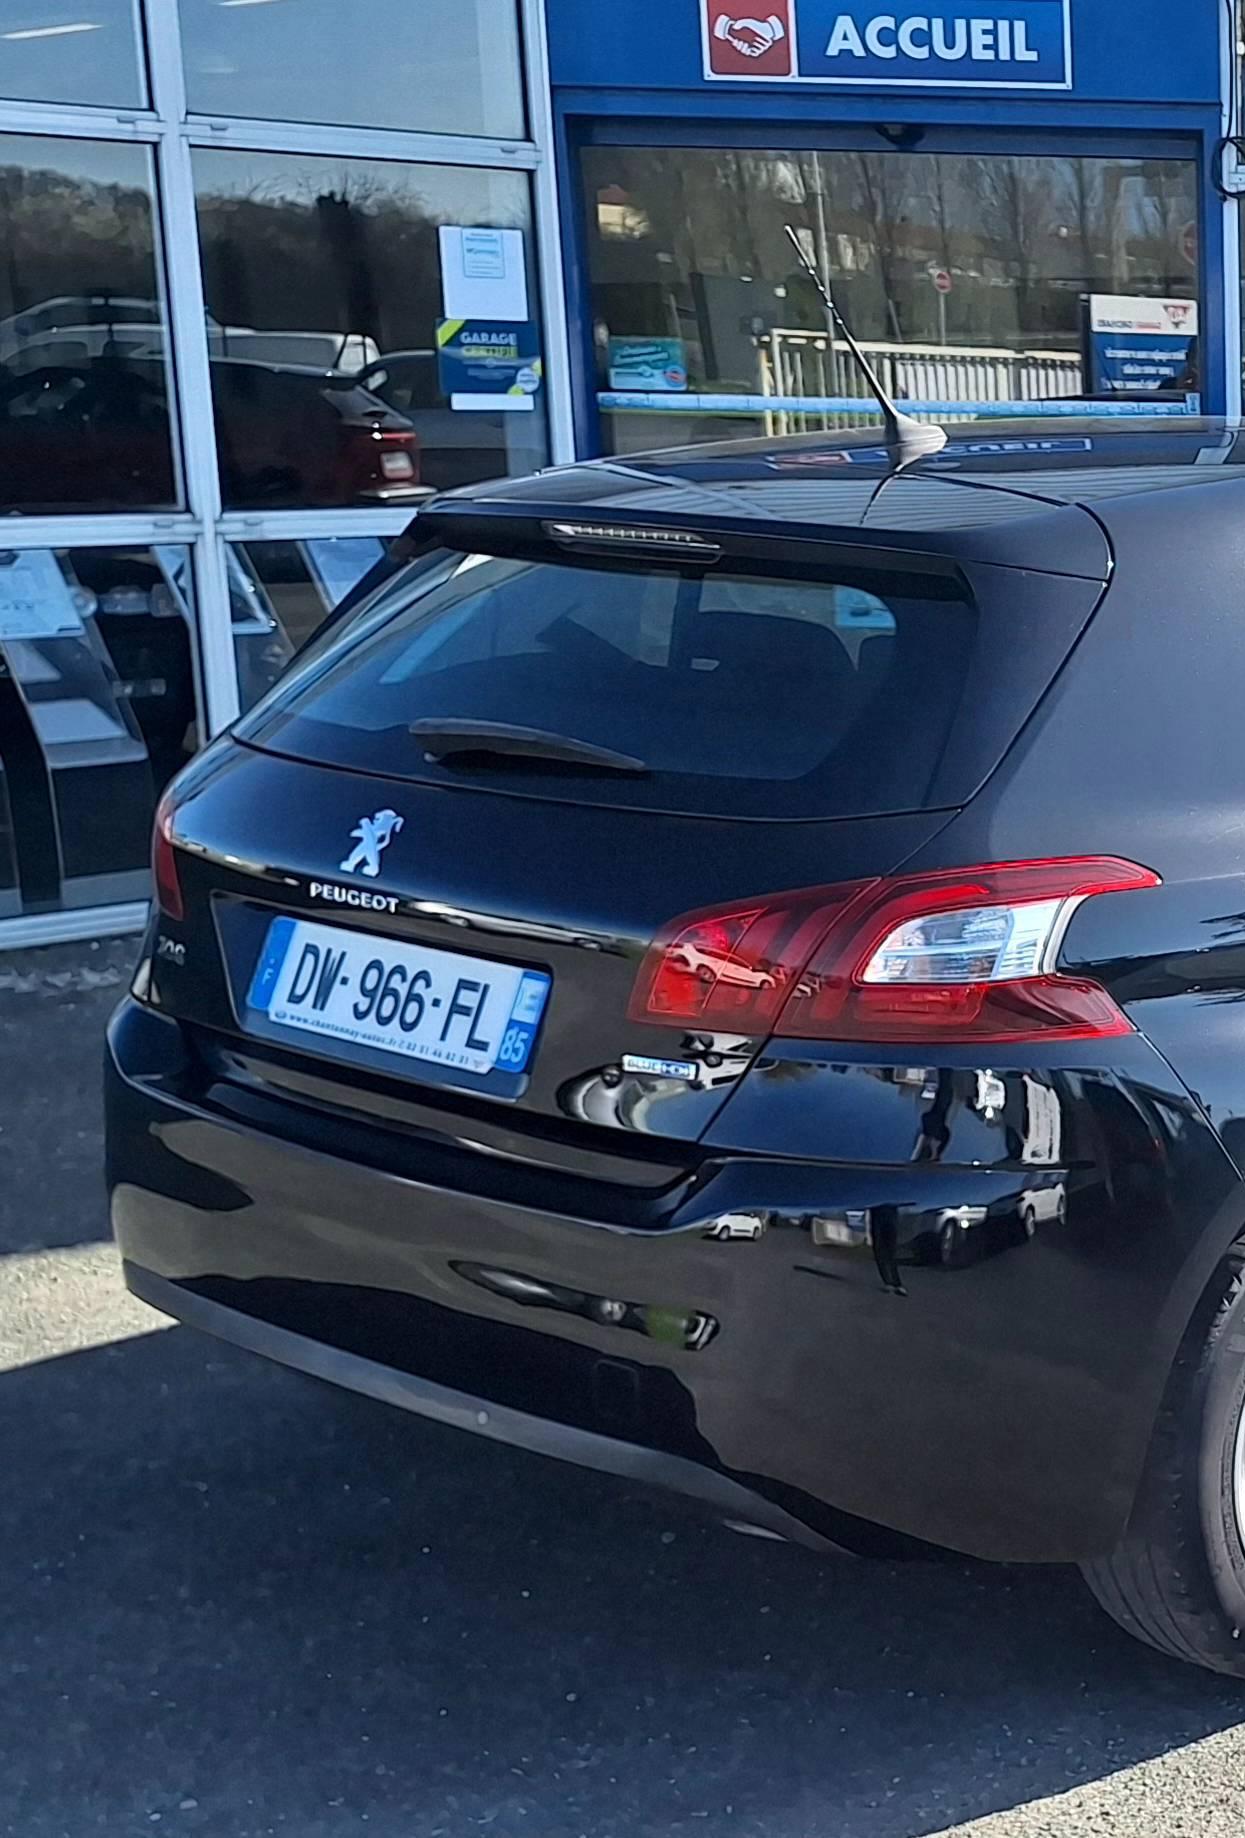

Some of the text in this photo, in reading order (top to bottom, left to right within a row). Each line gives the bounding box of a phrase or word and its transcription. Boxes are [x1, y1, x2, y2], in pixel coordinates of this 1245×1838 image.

[824, 15, 1039, 61] ACCUEIL
[460, 331, 518, 345] GARAGE
[310, 882, 400, 914] PEUGEOT
[500, 1026, 529, 1063] 85
